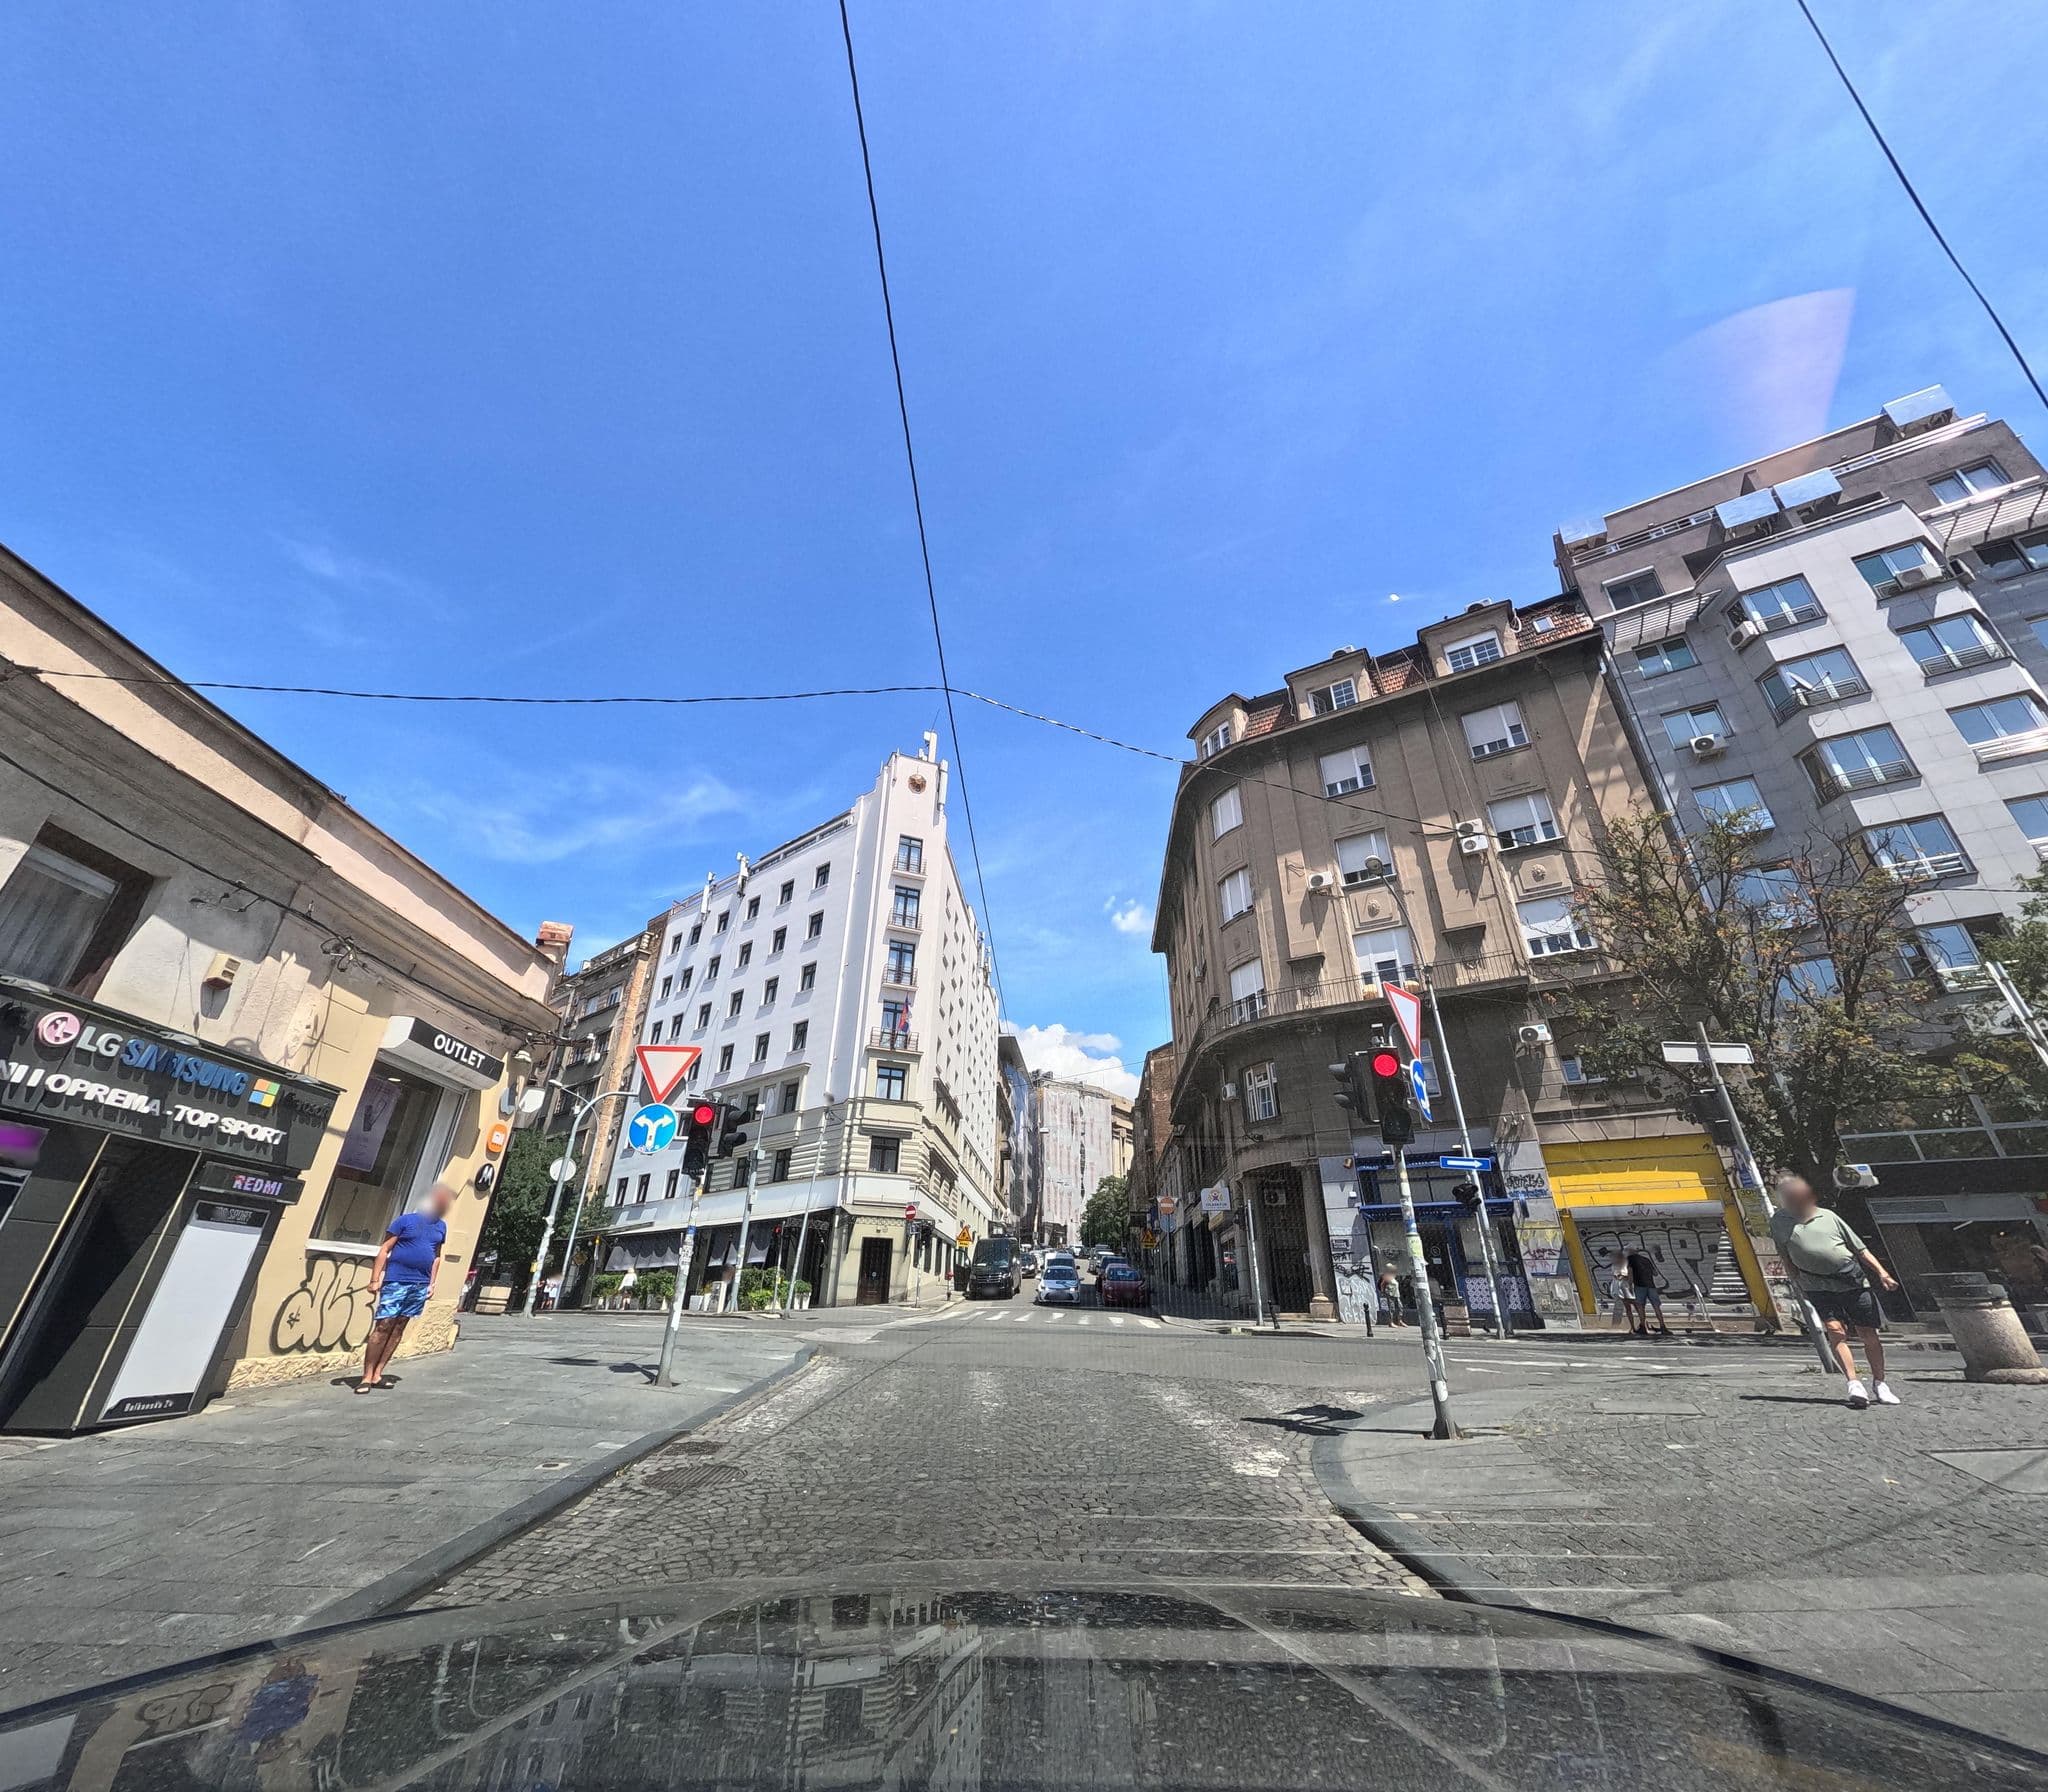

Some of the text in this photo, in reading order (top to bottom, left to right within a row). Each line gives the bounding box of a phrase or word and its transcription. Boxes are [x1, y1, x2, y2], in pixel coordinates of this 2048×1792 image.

[76, 1026, 123, 1057] LG
[434, 1034, 486, 1069] OUTLET
[121, 1038, 249, 1096] SAMSUNG
[45, 1073, 160, 1116] OPREMA
[173, 1104, 219, 1128] TOP
[218, 1117, 287, 1145] SPORT
[232, 1174, 283, 1196] REDMI
